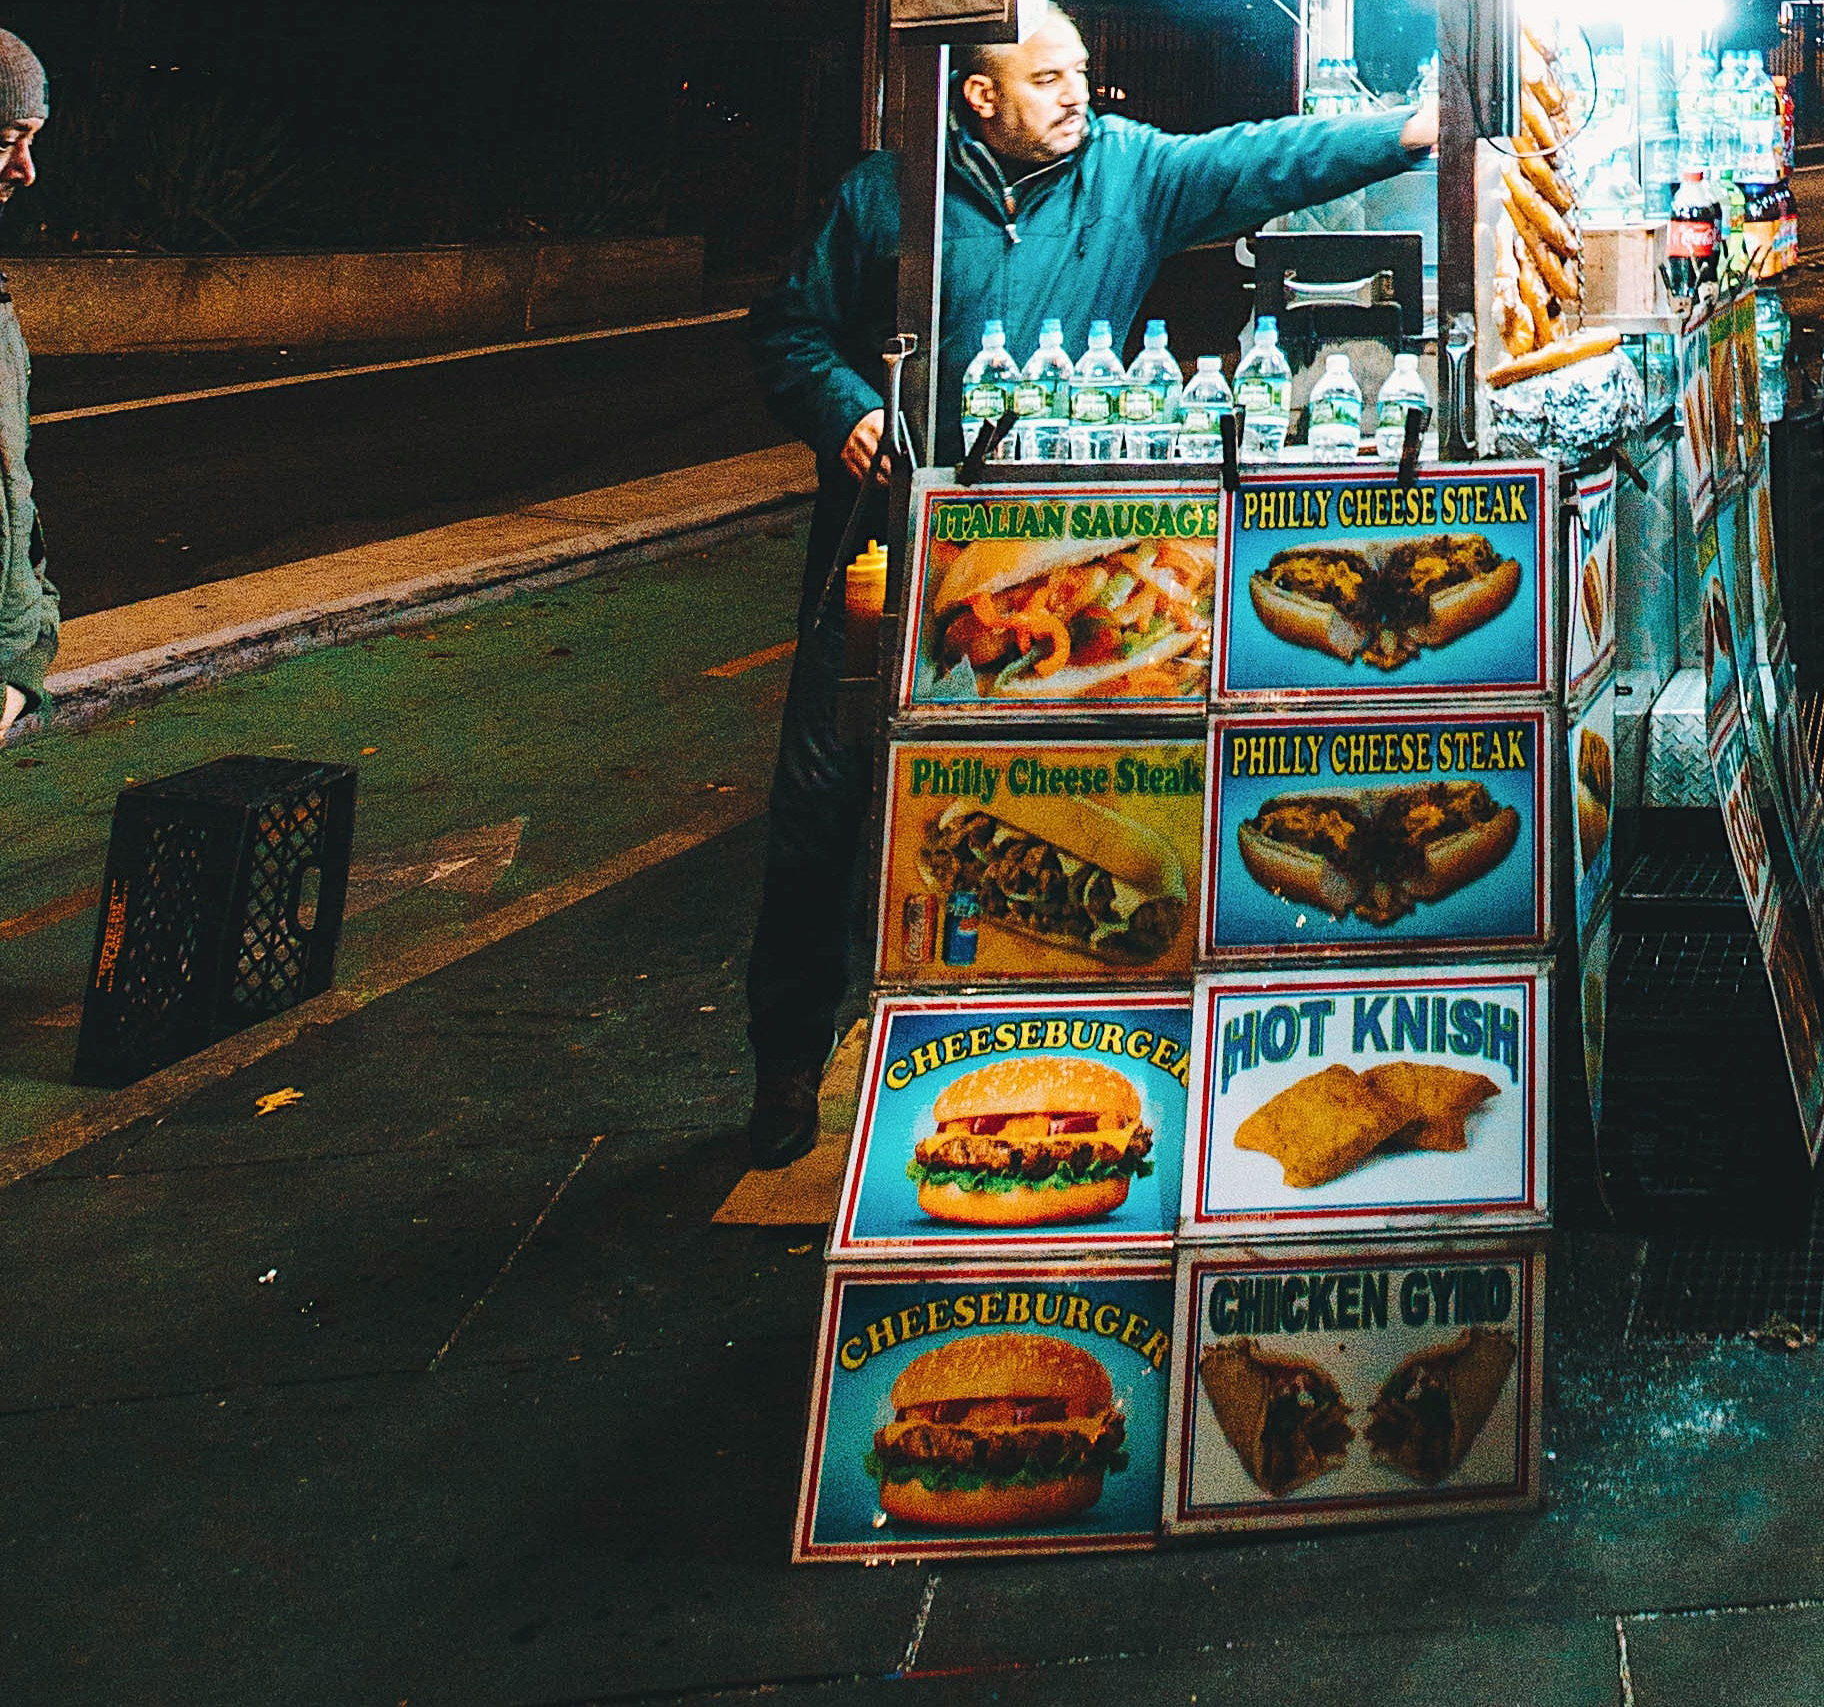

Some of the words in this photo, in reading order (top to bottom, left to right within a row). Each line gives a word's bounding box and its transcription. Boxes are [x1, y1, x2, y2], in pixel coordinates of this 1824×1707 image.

[935, 503, 1068, 542] ITALIAN
[1069, 501, 1219, 540] SAUSAGE
[1242, 489, 1333, 530] PHILLY
[1338, 486, 1436, 527] CHEESE
[1441, 483, 1529, 525] STEAK
[1232, 734, 1325, 776] PHILLY
[1330, 731, 1433, 774] CHEESE
[1437, 729, 1527, 771] STEAK
[910, 757, 1000, 805] Philly
[1007, 757, 1109, 796] Cheese
[1113, 757, 1205, 796] Steak
[1220, 997, 1336, 1095] HOT
[1351, 995, 1520, 1086] KNISH
[1208, 1272, 1390, 1336] CHICKEN
[1399, 1267, 1512, 1328] GYRO
[839, 1291, 1173, 1371] CHEESEBURGER
